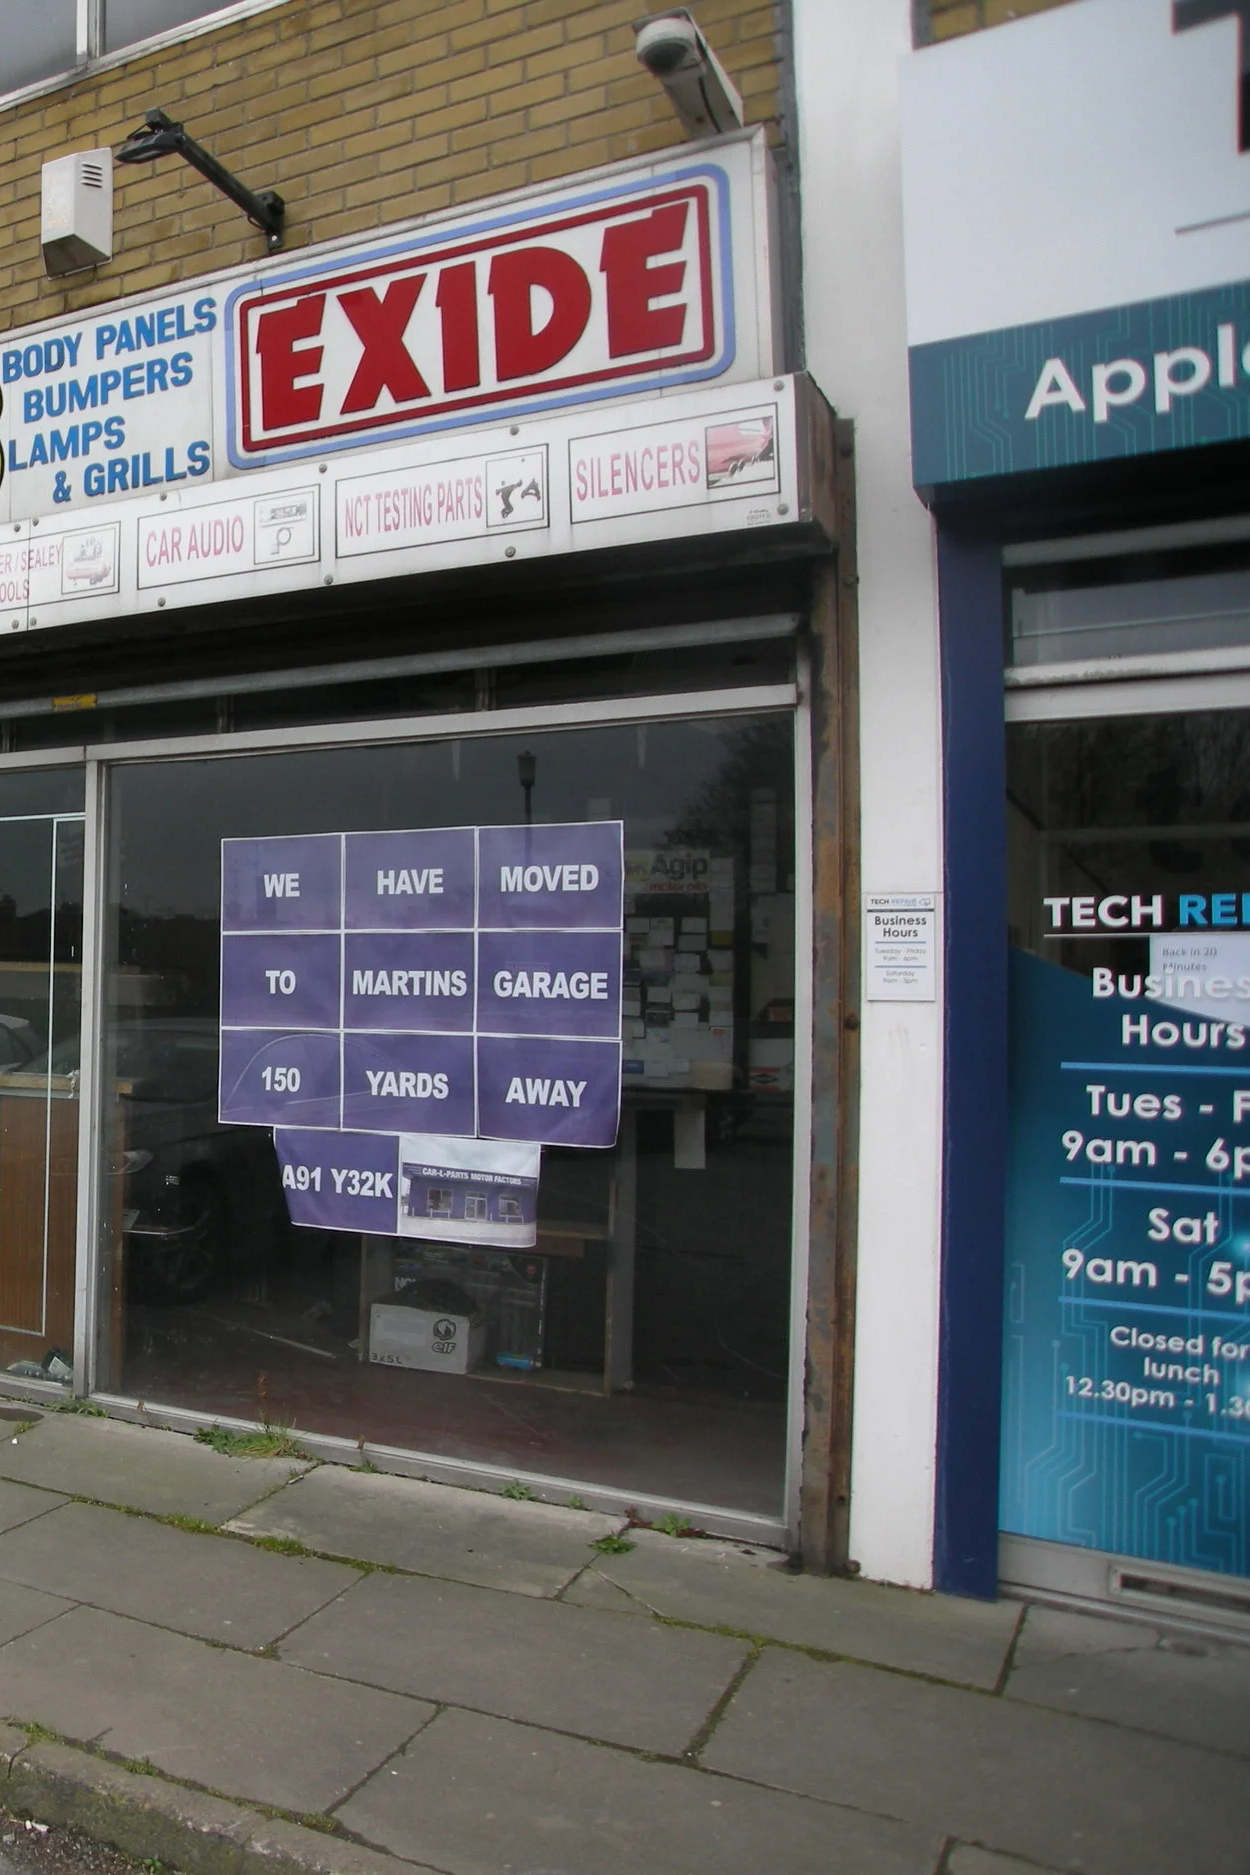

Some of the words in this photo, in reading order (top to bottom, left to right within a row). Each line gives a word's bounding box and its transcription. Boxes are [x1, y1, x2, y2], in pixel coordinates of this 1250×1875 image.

[256, 200, 689, 432] EXIDE
[2, 332, 83, 384] BODY
[96, 297, 217, 361] PANELS
[23, 351, 193, 424] BUMPERS
[1024, 323, 1250, 423] Appl
[8, 415, 126, 472] LAMPS
[52, 470, 71, 504] &
[84, 440, 211, 497] GRILLS
[575, 440, 701, 501] SILENCERS
[345, 497, 369, 537] NCT
[373, 483, 434, 534] TESTING
[437, 474, 483, 524] PARTS
[21, 543, 63, 571] SEALEY
[146, 527, 182, 567] CAR
[187, 515, 245, 561] AUDIO
[263, 873, 300, 898] WE
[376, 868, 444, 895] HAVE
[500, 864, 599, 892] MOVED
[650, 854, 708, 881] Agip
[874, 915, 927, 926] Business
[1043, 894, 1163, 928] TECH
[883, 927, 919, 938] Hours
[1162, 946, 1187, 957] Back
[1190, 947, 1201, 957] in
[265, 969, 297, 995] TO
[352, 969, 467, 997] MARTINS
[493, 970, 608, 1000] GARAGE
[885, 969, 916, 977] Saturday
[1122, 1014, 1247, 1048] Hours
[261, 1066, 301, 1093] 150
[366, 1070, 449, 1100] YARDS
[505, 1077, 587, 1108] AWAY
[1086, 1084, 1182, 1120] Tues
[1061, 1130, 1157, 1167] 9am
[282, 1165, 322, 1192] A91
[330, 1168, 393, 1199] Y32K
[422, 1166, 469, 1180] CAR-L-PARTS
[470, 1173, 493, 1183] MOTOR
[494, 1175, 522, 1186] FACTORS
[1147, 1207, 1219, 1245] Sat
[1061, 1248, 1157, 1288] 9am
[431, 1342, 456, 1354] elf
[1110, 1326, 1203, 1355] Closed
[1211, 1336, 1250, 1360] for
[1143, 1356, 1220, 1386] lunch
[1065, 1374, 1175, 1410] 12.30pm
